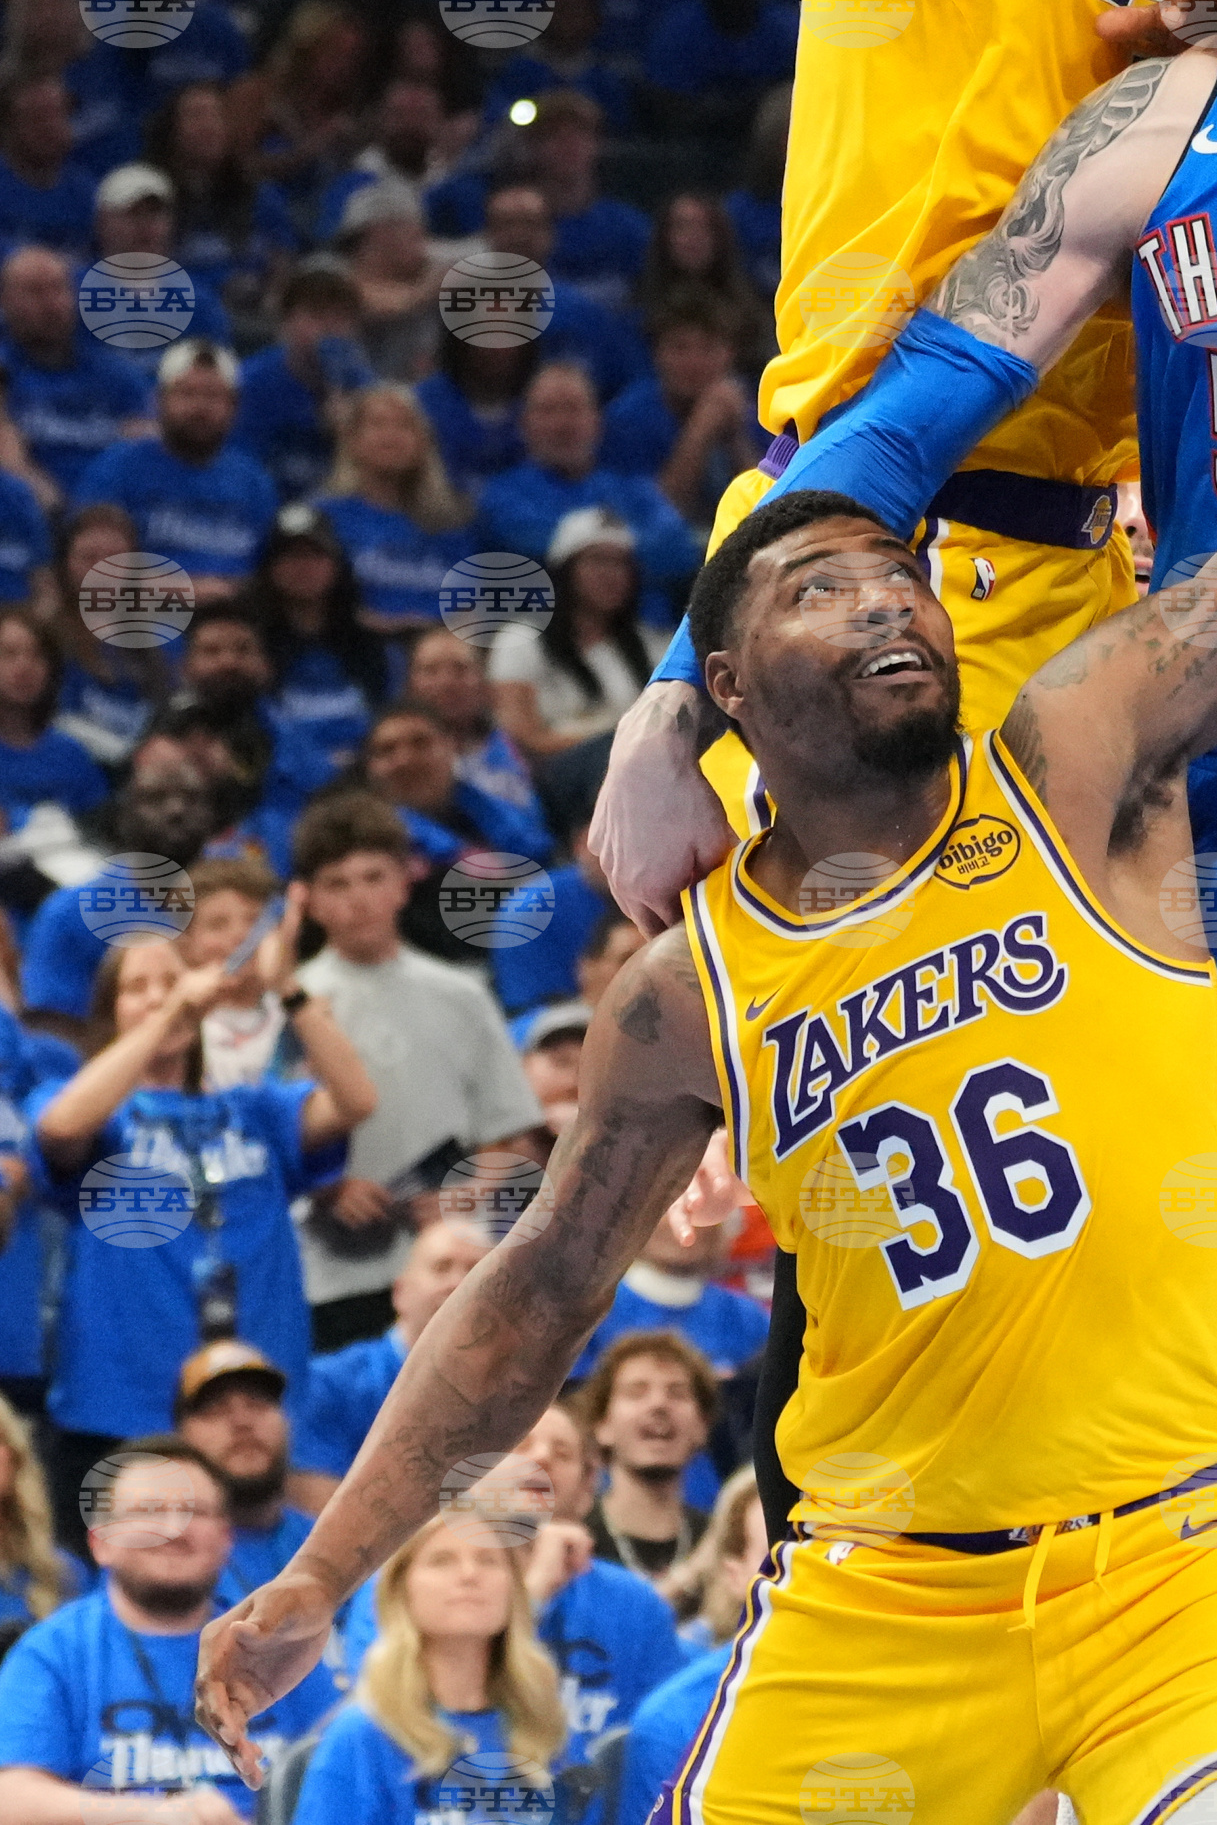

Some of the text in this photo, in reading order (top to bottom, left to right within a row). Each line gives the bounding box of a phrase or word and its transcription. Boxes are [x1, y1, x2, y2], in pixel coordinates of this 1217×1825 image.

[939, 830, 1013, 870] bibigo
[957, 856, 990, 875] 비비고
[763, 912, 1068, 1163] LAKERS
[836, 1058, 1092, 1310] 36
